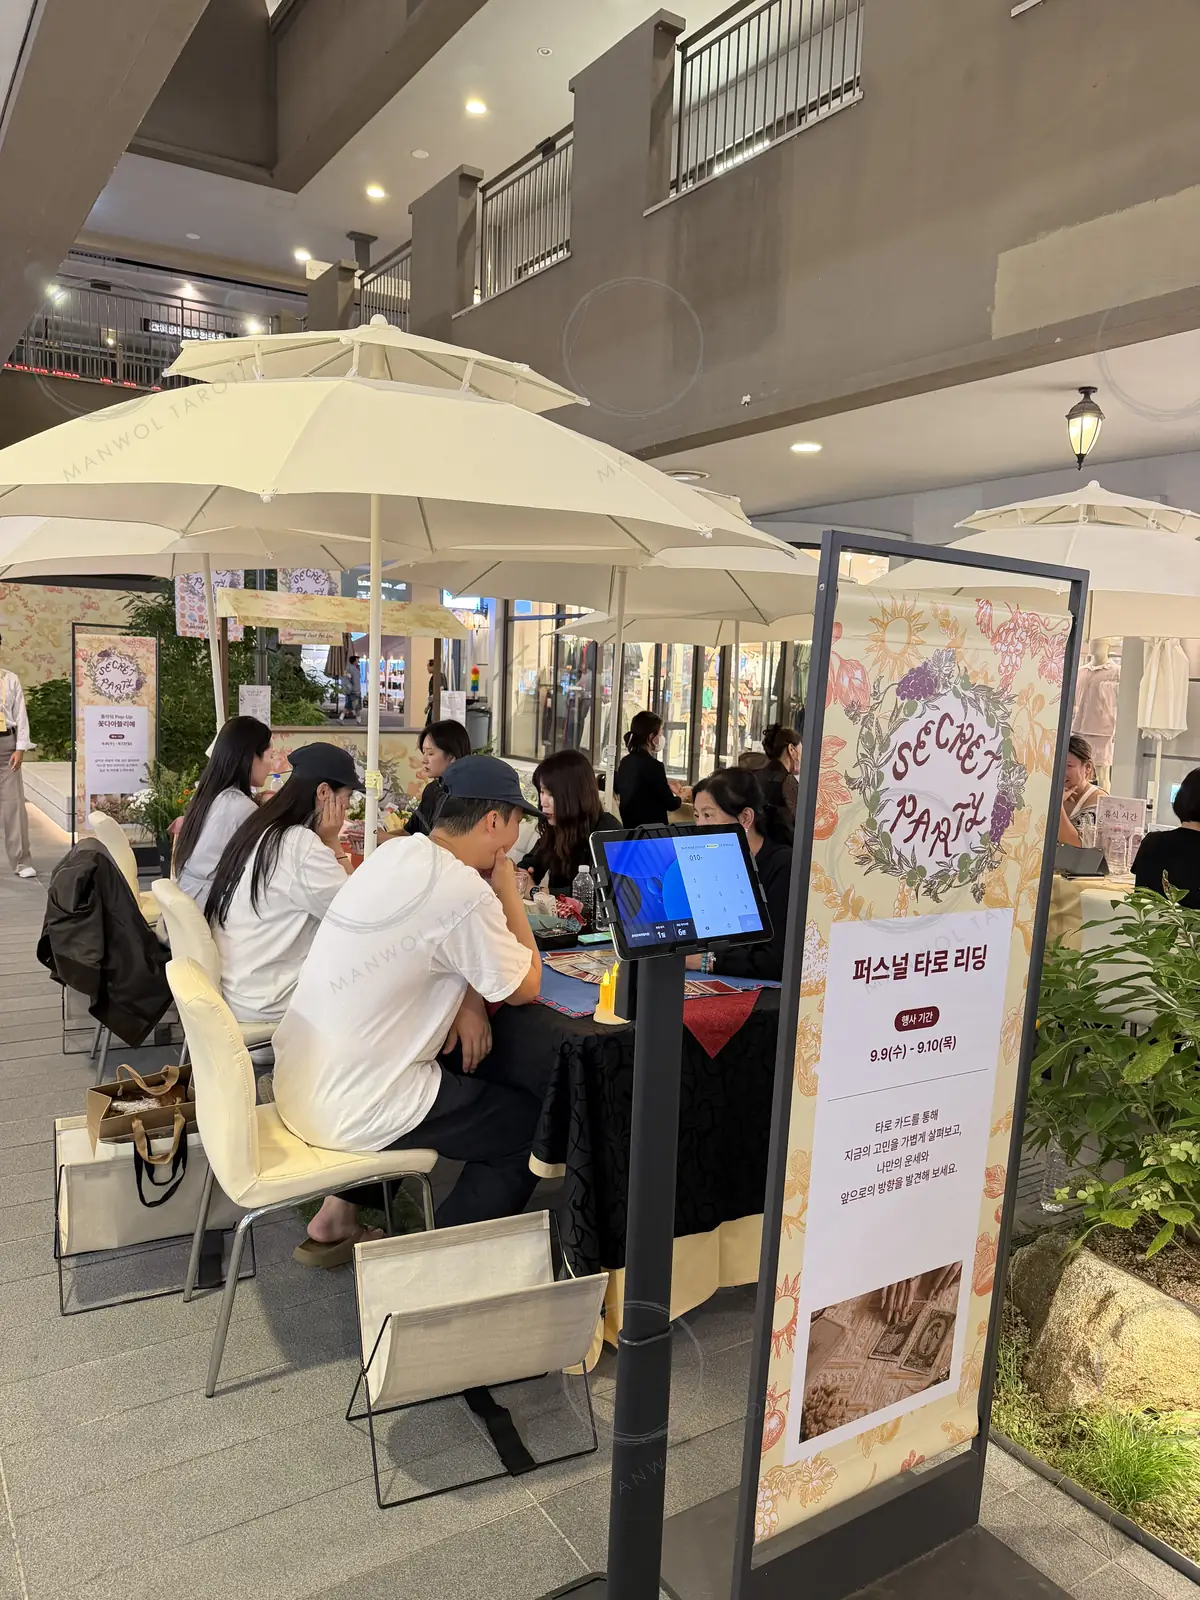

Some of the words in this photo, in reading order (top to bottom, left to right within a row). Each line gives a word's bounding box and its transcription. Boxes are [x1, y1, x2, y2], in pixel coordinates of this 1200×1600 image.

[293, 569, 328, 586] SECRET
[99, 660, 136, 676] SECRET
[100, 678, 134, 694] PARTY
[893, 713, 1002, 780] SECRET
[890, 792, 987, 858] PARTY
[1104, 810, 1119, 820] 휴식
[1121, 811, 1138, 822] 시간
[852, 953, 909, 984] 퍼스널
[914, 949, 949, 977] 타로
[954, 944, 988, 972] 리딩
[901, 1014, 917, 1027] 행사
[918, 1011, 934, 1024] 기간
[870, 1044, 907, 1062] 9.9(수)
[917, 1036, 957, 1053] 9.10(목)
[875, 1119, 893, 1134] 타로
[894, 1114, 920, 1129] 카드를
[921, 1109, 939, 1123] 통해
[844, 1145, 871, 1162] 지금의
[873, 1138, 899, 1155] 고민을
[900, 1131, 926, 1148] 가볍게
[928, 1124, 962, 1142] 살펴보고,
[876, 1157, 902, 1174] 나만의
[904, 1150, 930, 1167] 운세와
[840, 1184, 876, 1206] 앞으로의
[878, 1177, 903, 1194] 방향을
[905, 1169, 930, 1187] 발견해
[932, 1163, 958, 1179] 보세요.
